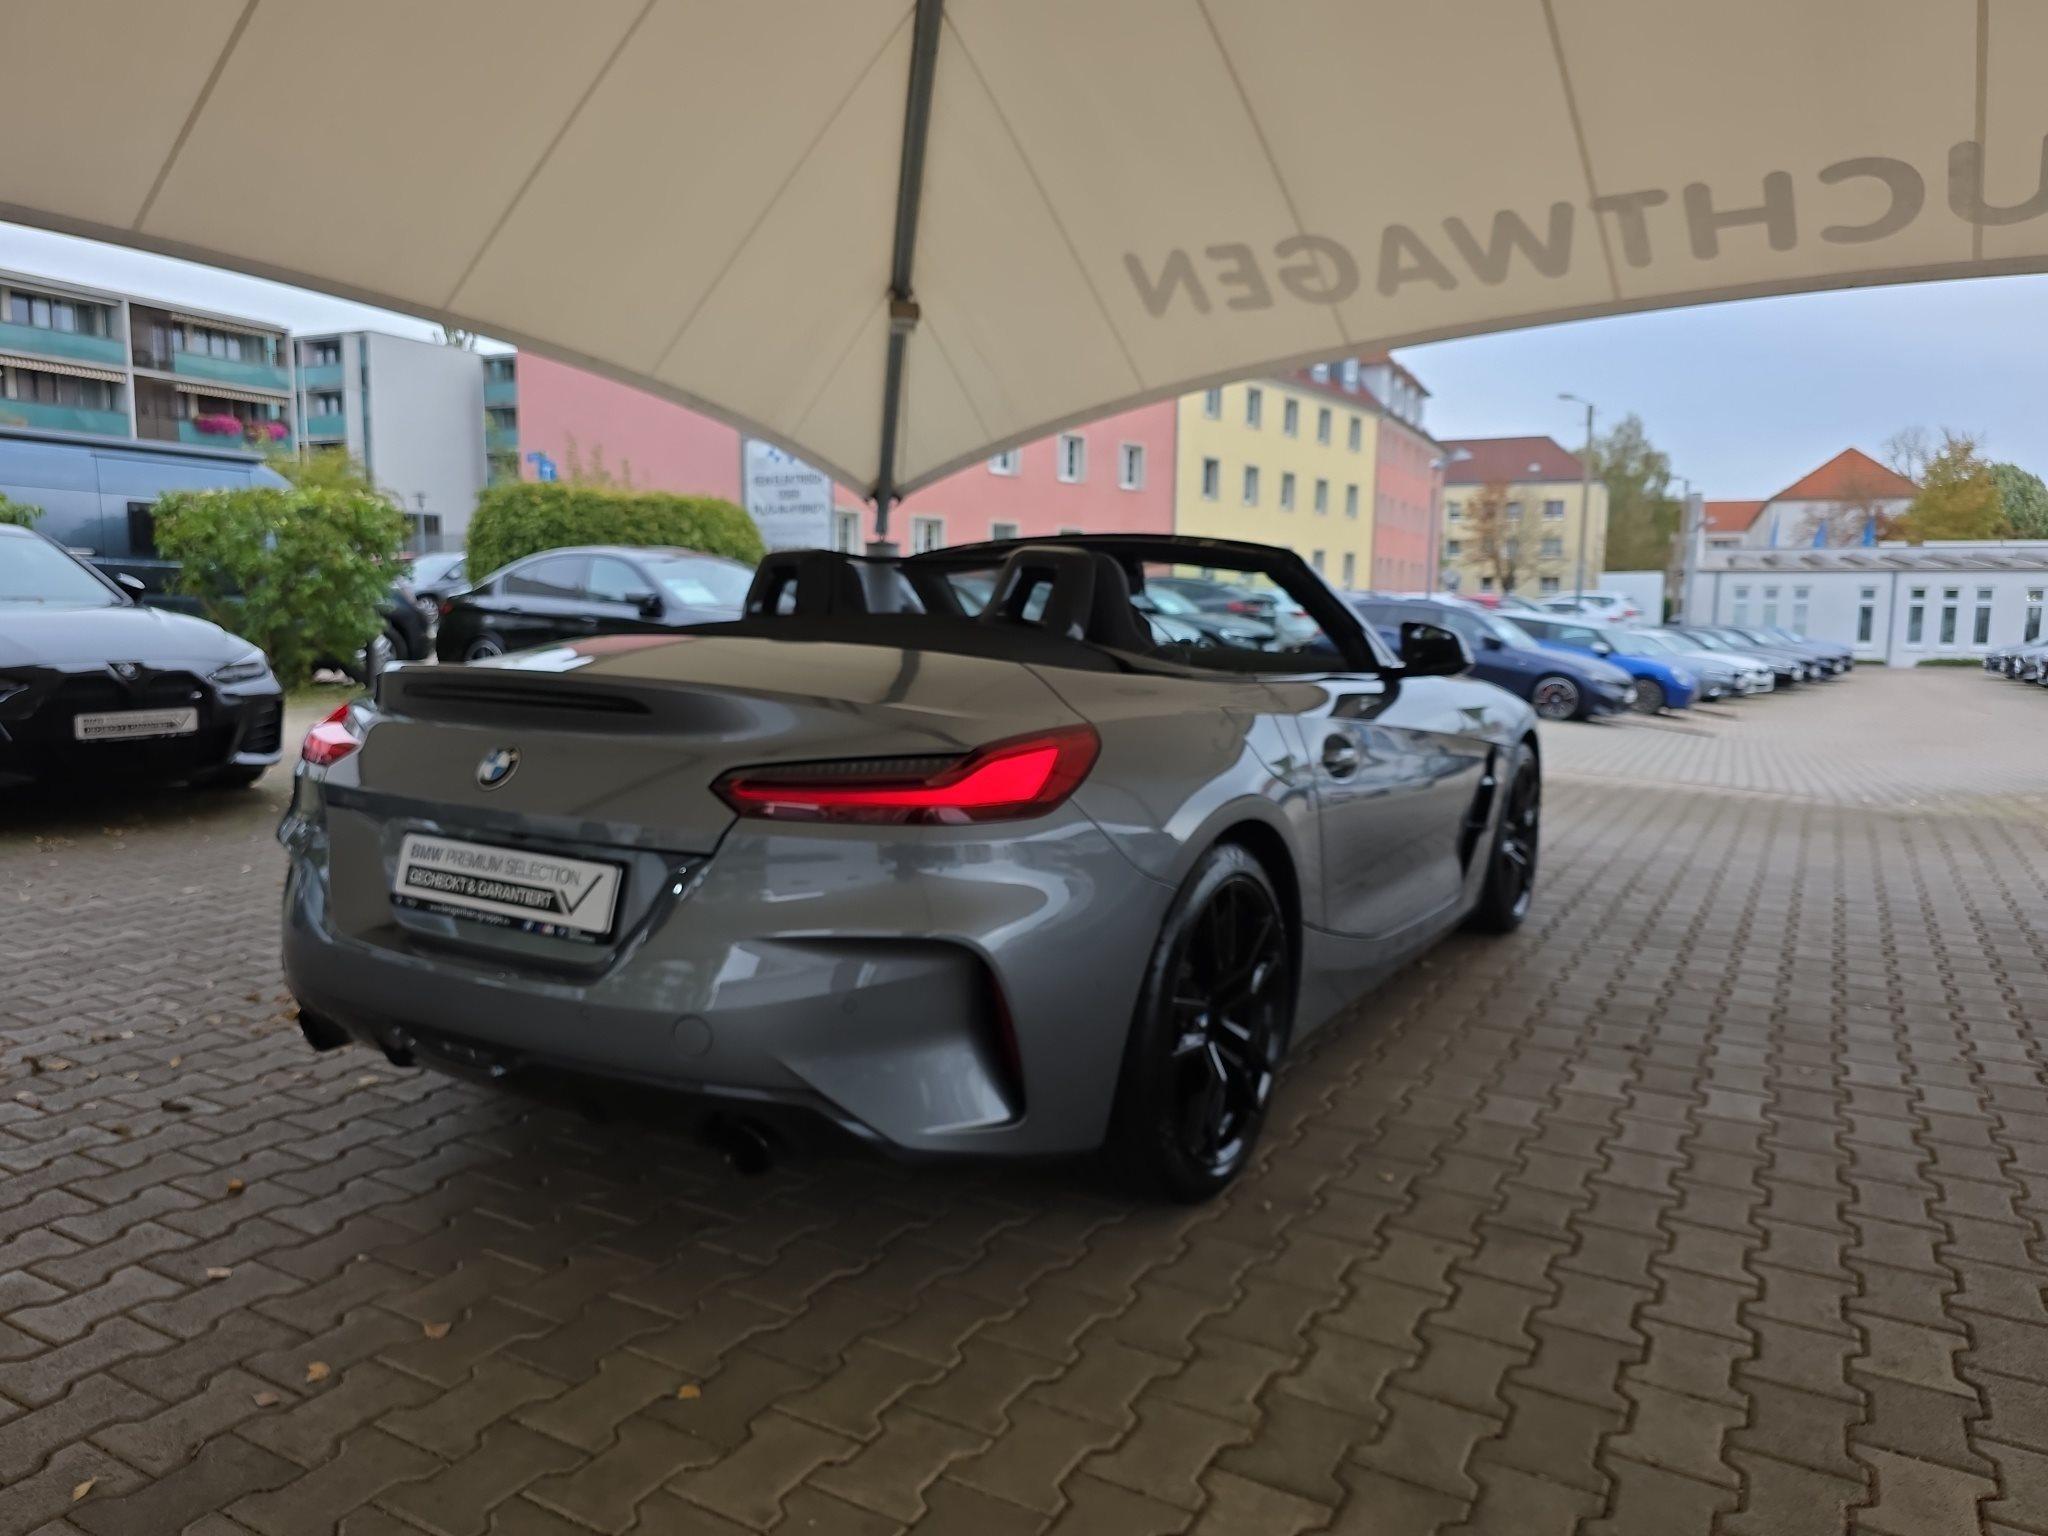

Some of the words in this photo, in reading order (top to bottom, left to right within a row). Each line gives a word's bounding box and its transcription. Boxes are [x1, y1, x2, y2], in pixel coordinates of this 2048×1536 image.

[411, 843, 443, 861] BMW
[446, 851, 503, 873] PREMIUM
[504, 858, 582, 886] SELECTION
[409, 869, 467, 893] GECHECKT
[467, 881, 476, 894] &
[477, 881, 553, 908] GARANTIERT
